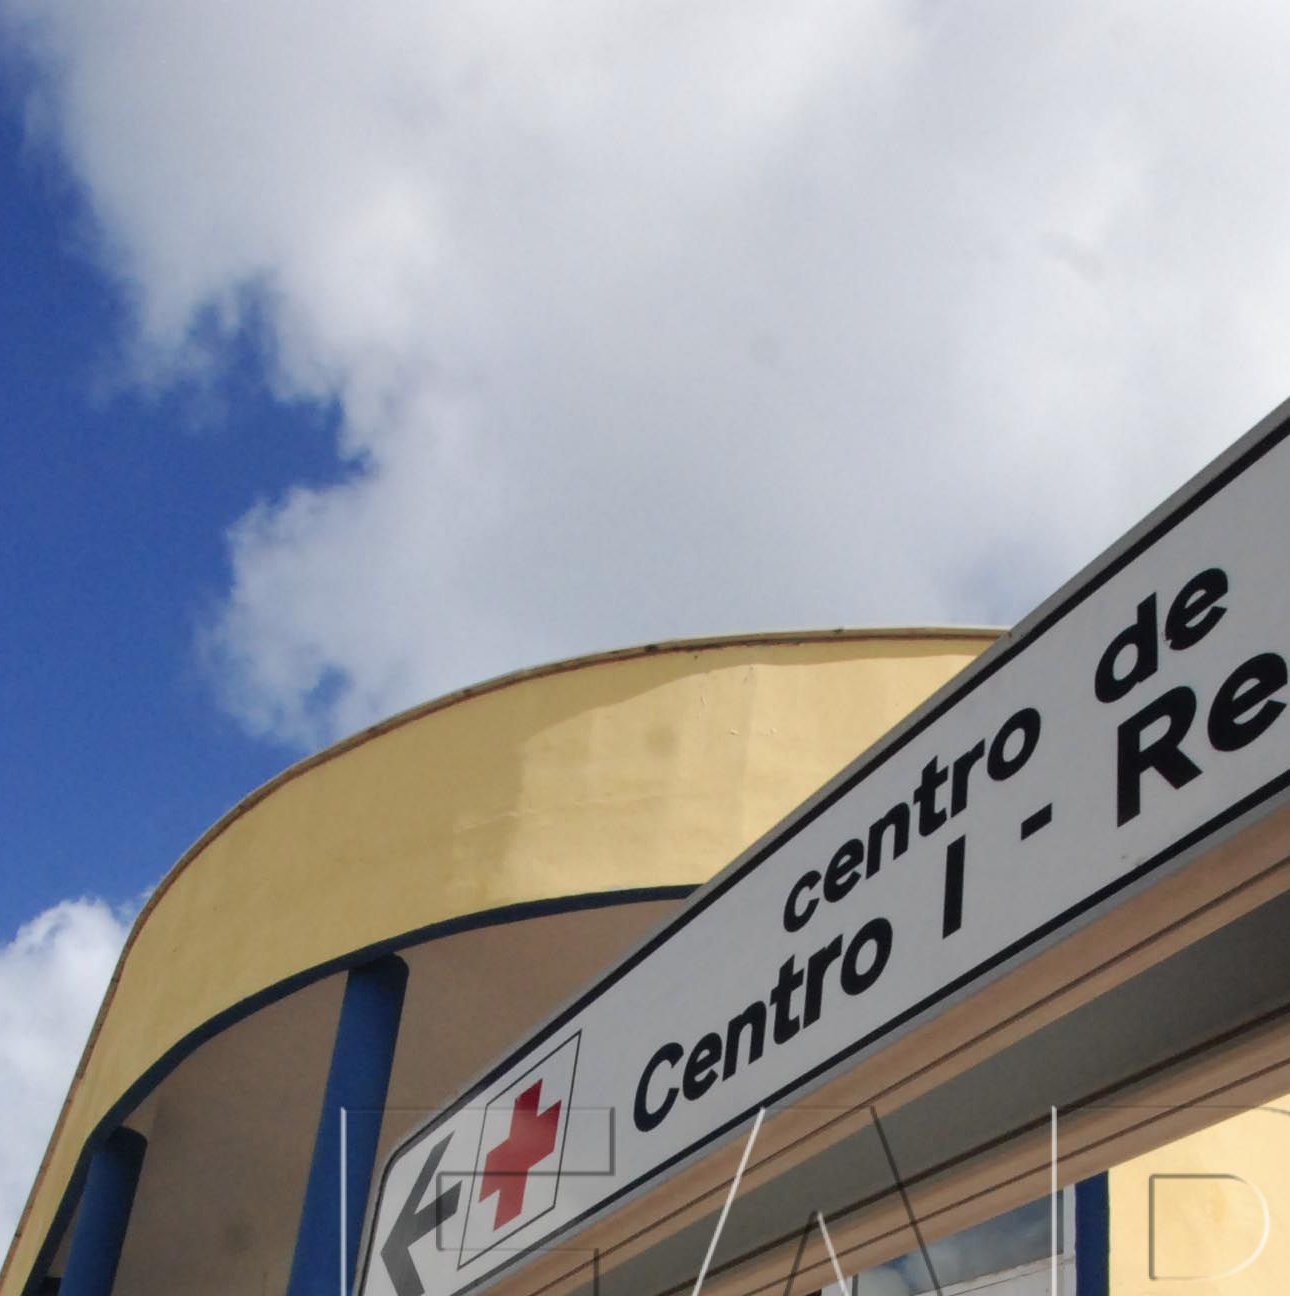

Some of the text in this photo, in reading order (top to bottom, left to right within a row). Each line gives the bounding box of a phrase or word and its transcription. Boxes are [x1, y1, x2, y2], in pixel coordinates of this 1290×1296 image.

[783, 708, 1041, 932] centro
[1095, 568, 1228, 704] de
[633, 918, 893, 1132] Centro
